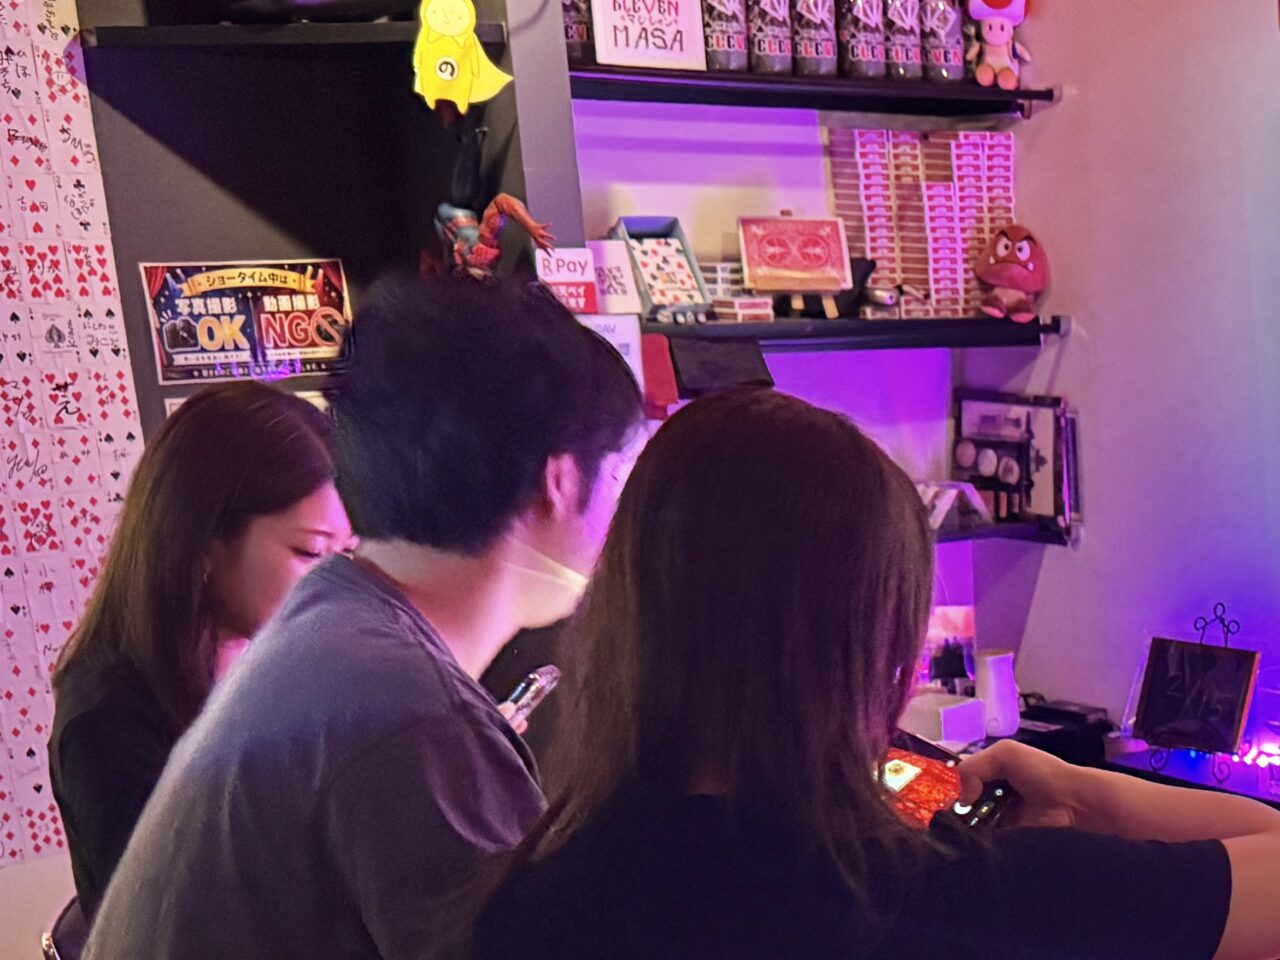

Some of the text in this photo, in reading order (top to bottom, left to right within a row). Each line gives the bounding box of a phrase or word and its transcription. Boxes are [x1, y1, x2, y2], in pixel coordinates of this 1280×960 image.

[612, 25, 684, 52] MASA
[556, 259, 588, 276] Pay
[206, 271, 288, 287] ショータイム中は
[175, 296, 238, 315] 写真撮影
[262, 295, 320, 312] 動画撮影
[198, 315, 250, 350] OK
[260, 312, 311, 349] NG
